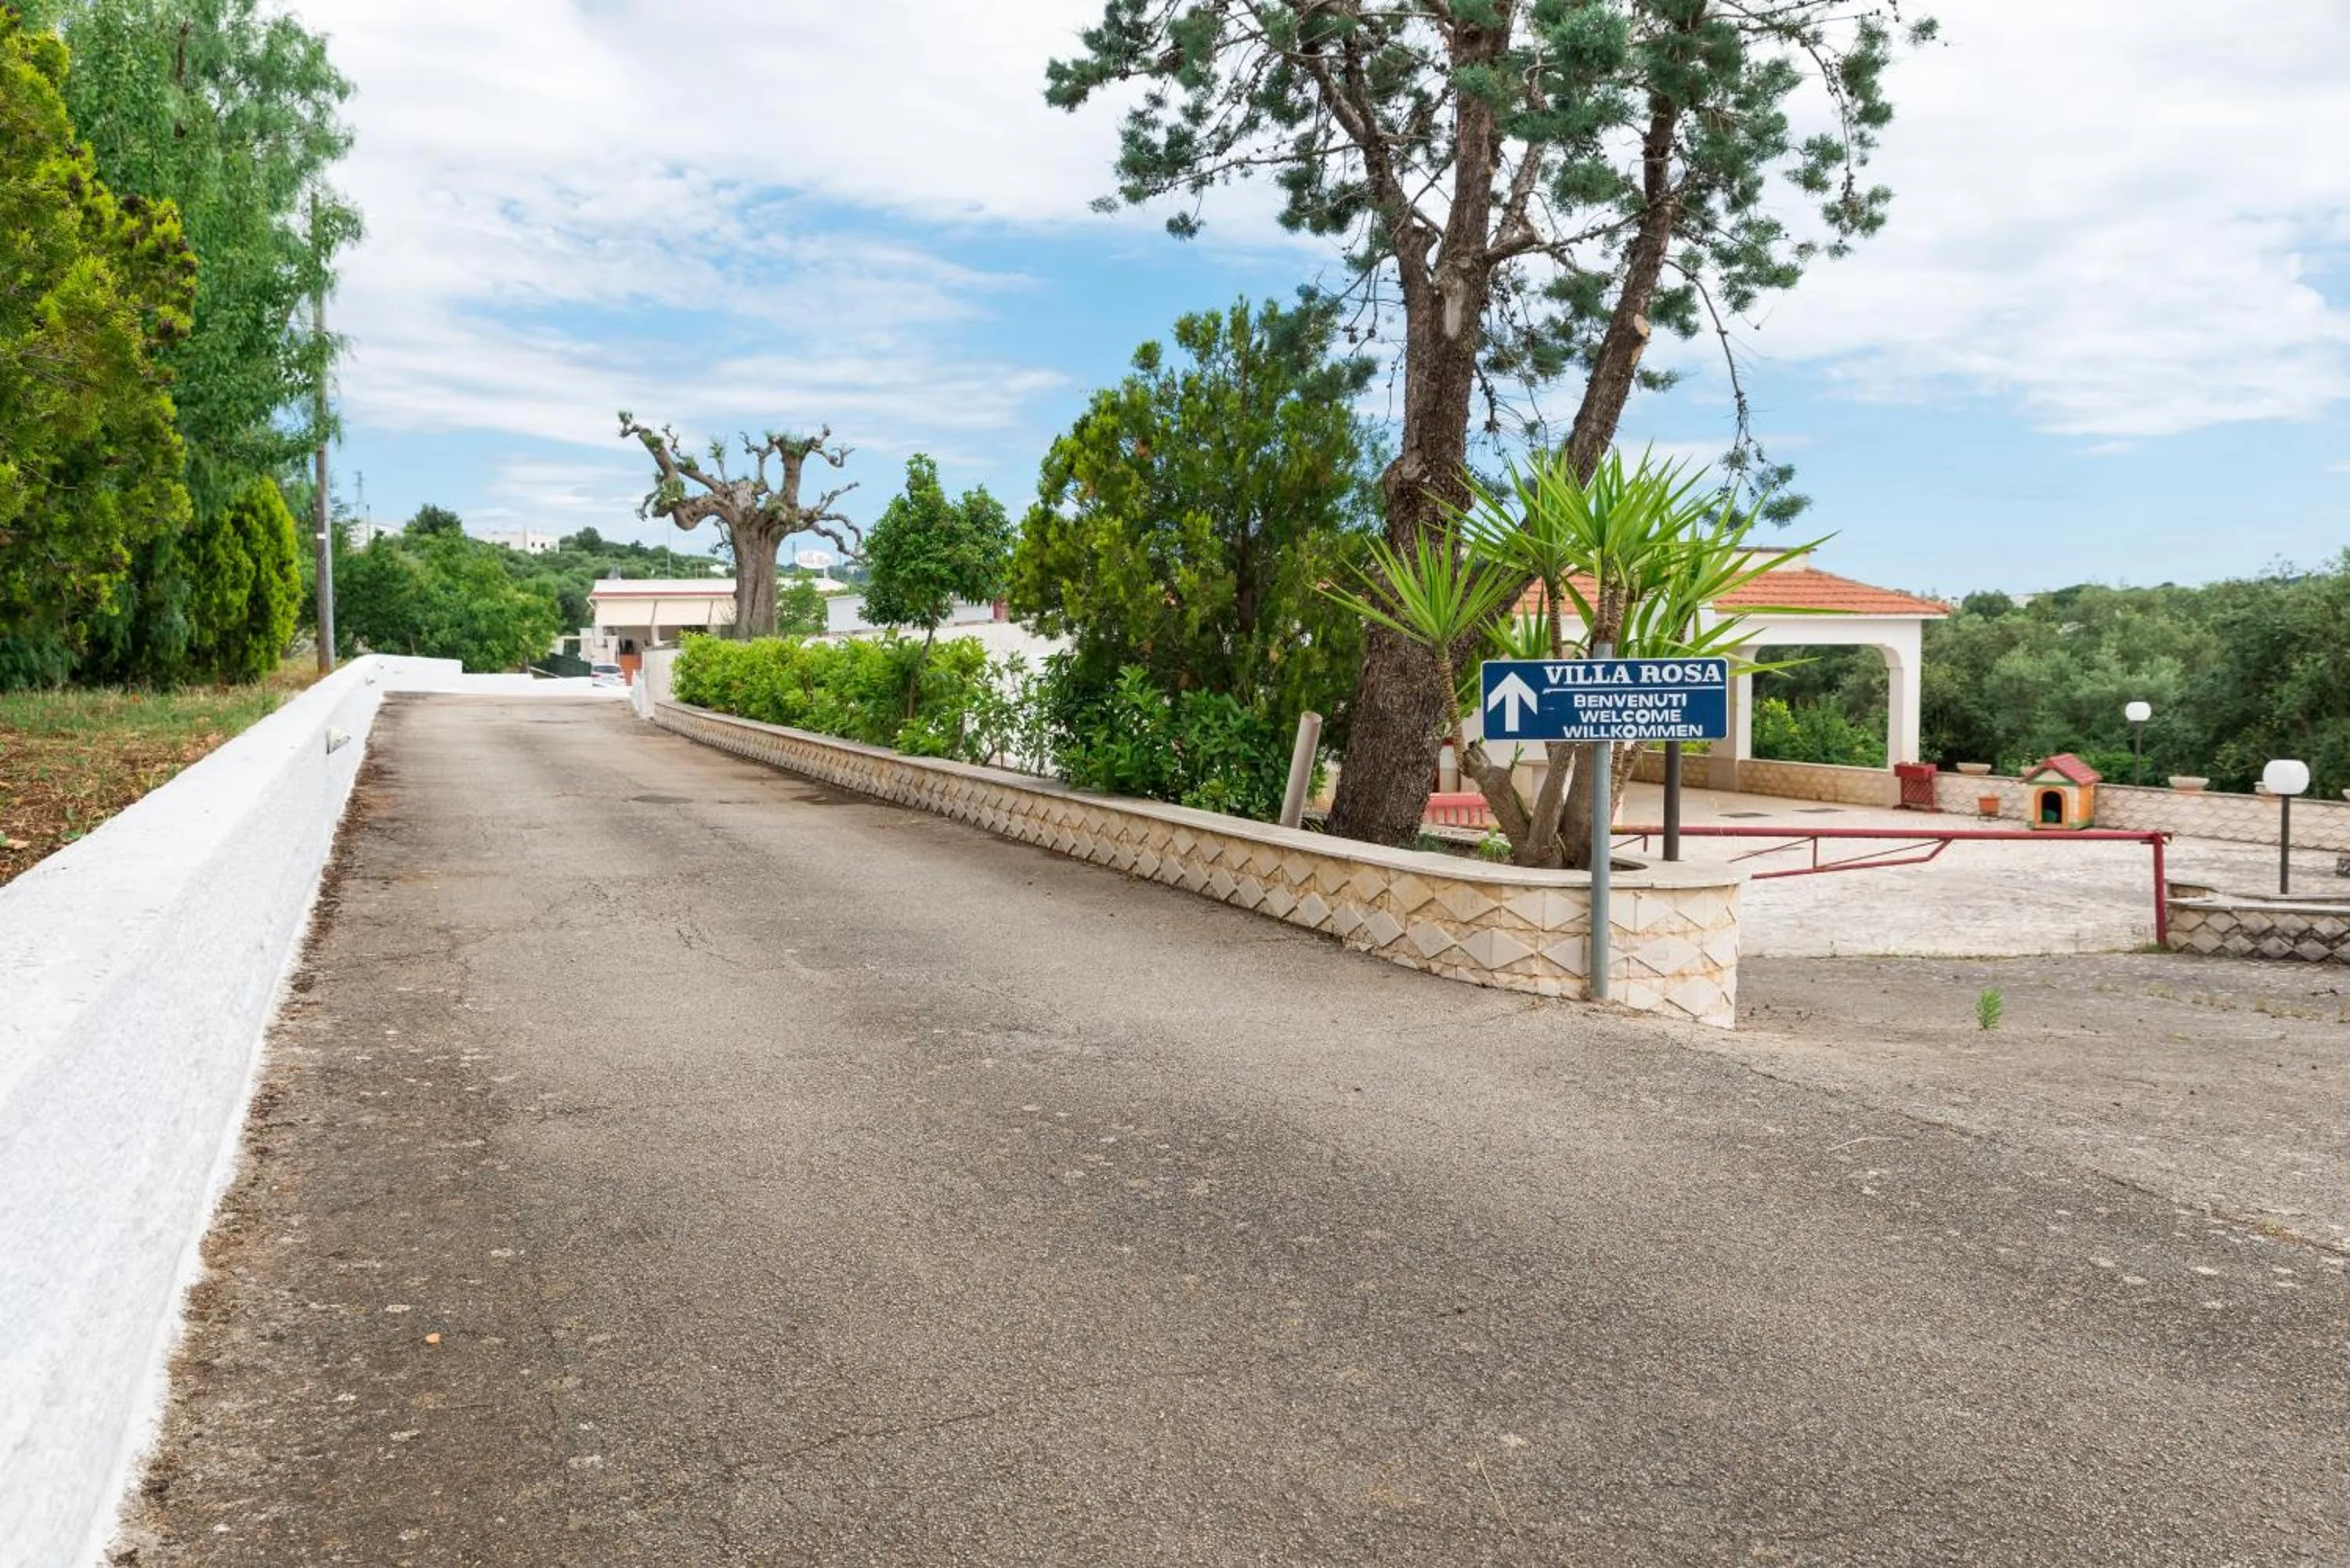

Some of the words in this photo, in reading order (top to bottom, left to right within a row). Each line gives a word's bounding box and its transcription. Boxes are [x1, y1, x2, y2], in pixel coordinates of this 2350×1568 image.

[1544, 664, 1632, 685] VILLA
[1639, 663, 1722, 683] ROSA
[1574, 693, 1687, 707] BENVENUTI
[1579, 709, 1682, 724] WELCOME
[1563, 724, 1704, 739] WILLKOMMEN
